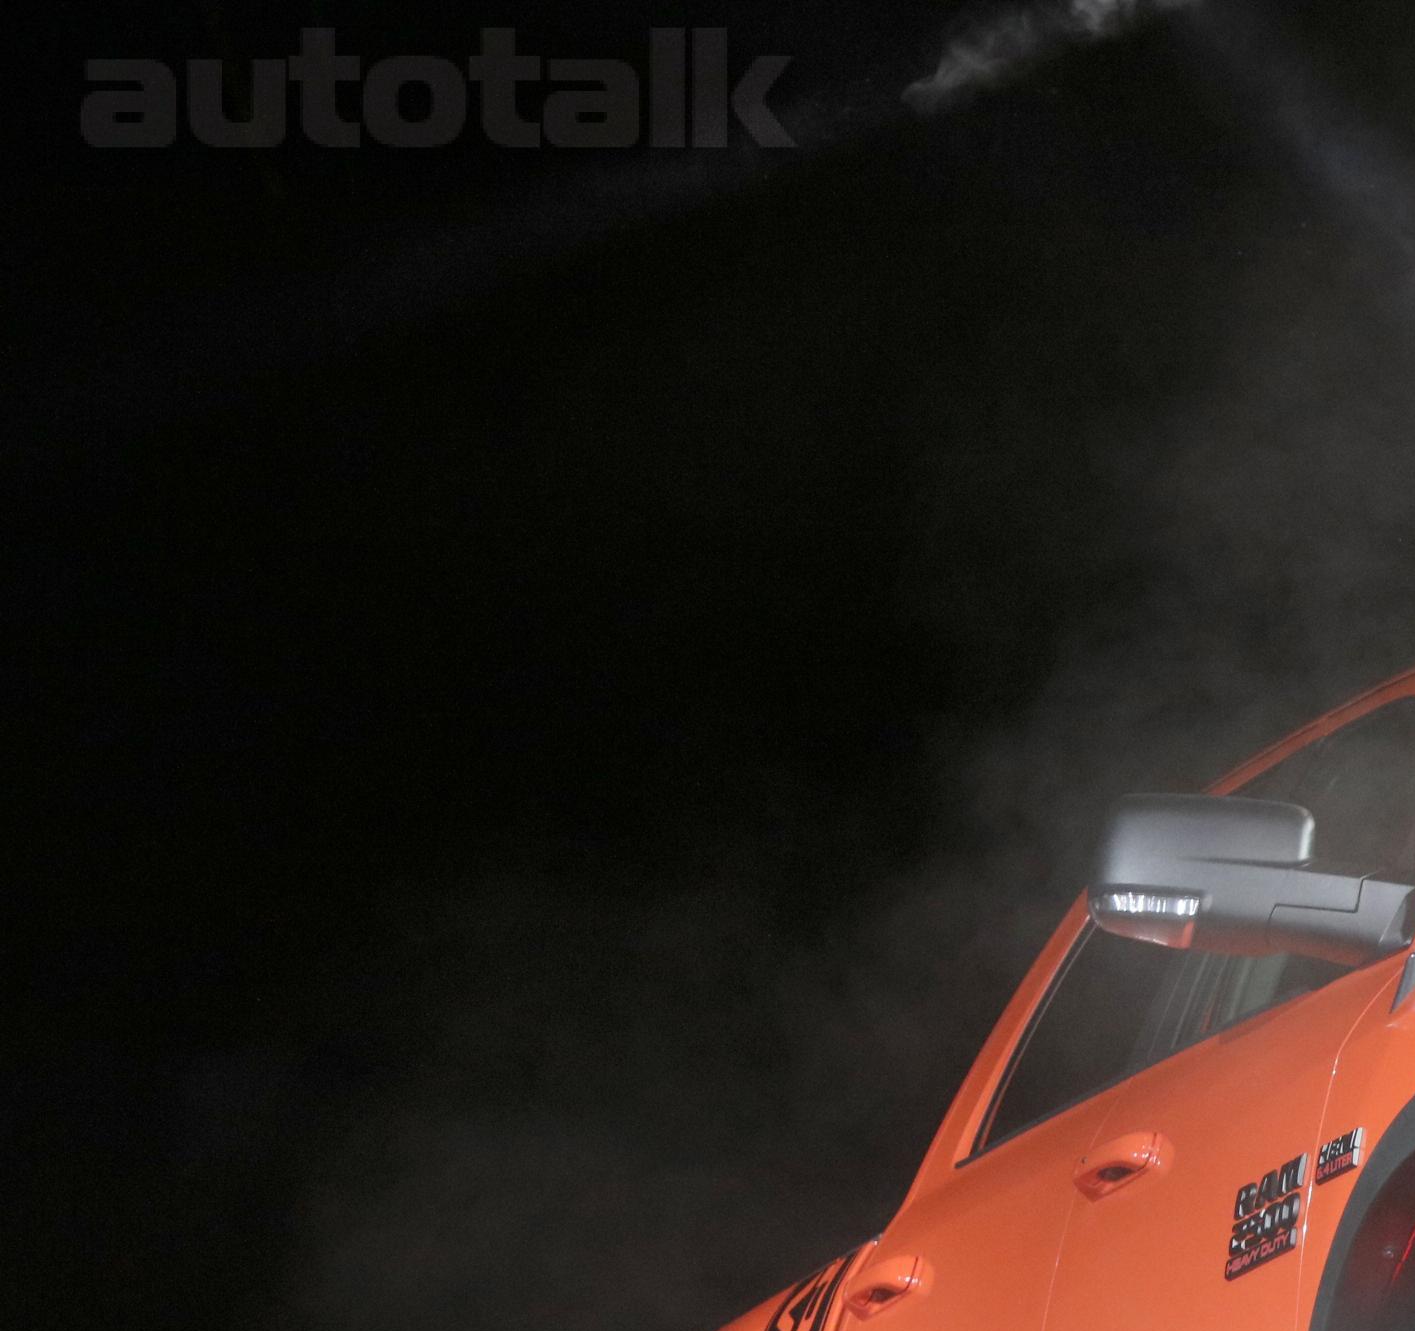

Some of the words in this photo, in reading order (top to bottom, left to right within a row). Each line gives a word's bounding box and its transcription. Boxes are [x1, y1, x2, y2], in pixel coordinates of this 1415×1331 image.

[1235, 1152, 1308, 1221] RAM
[1226, 1247, 1260, 1273] HEAVY
[1260, 1231, 1289, 1258] DUTY
